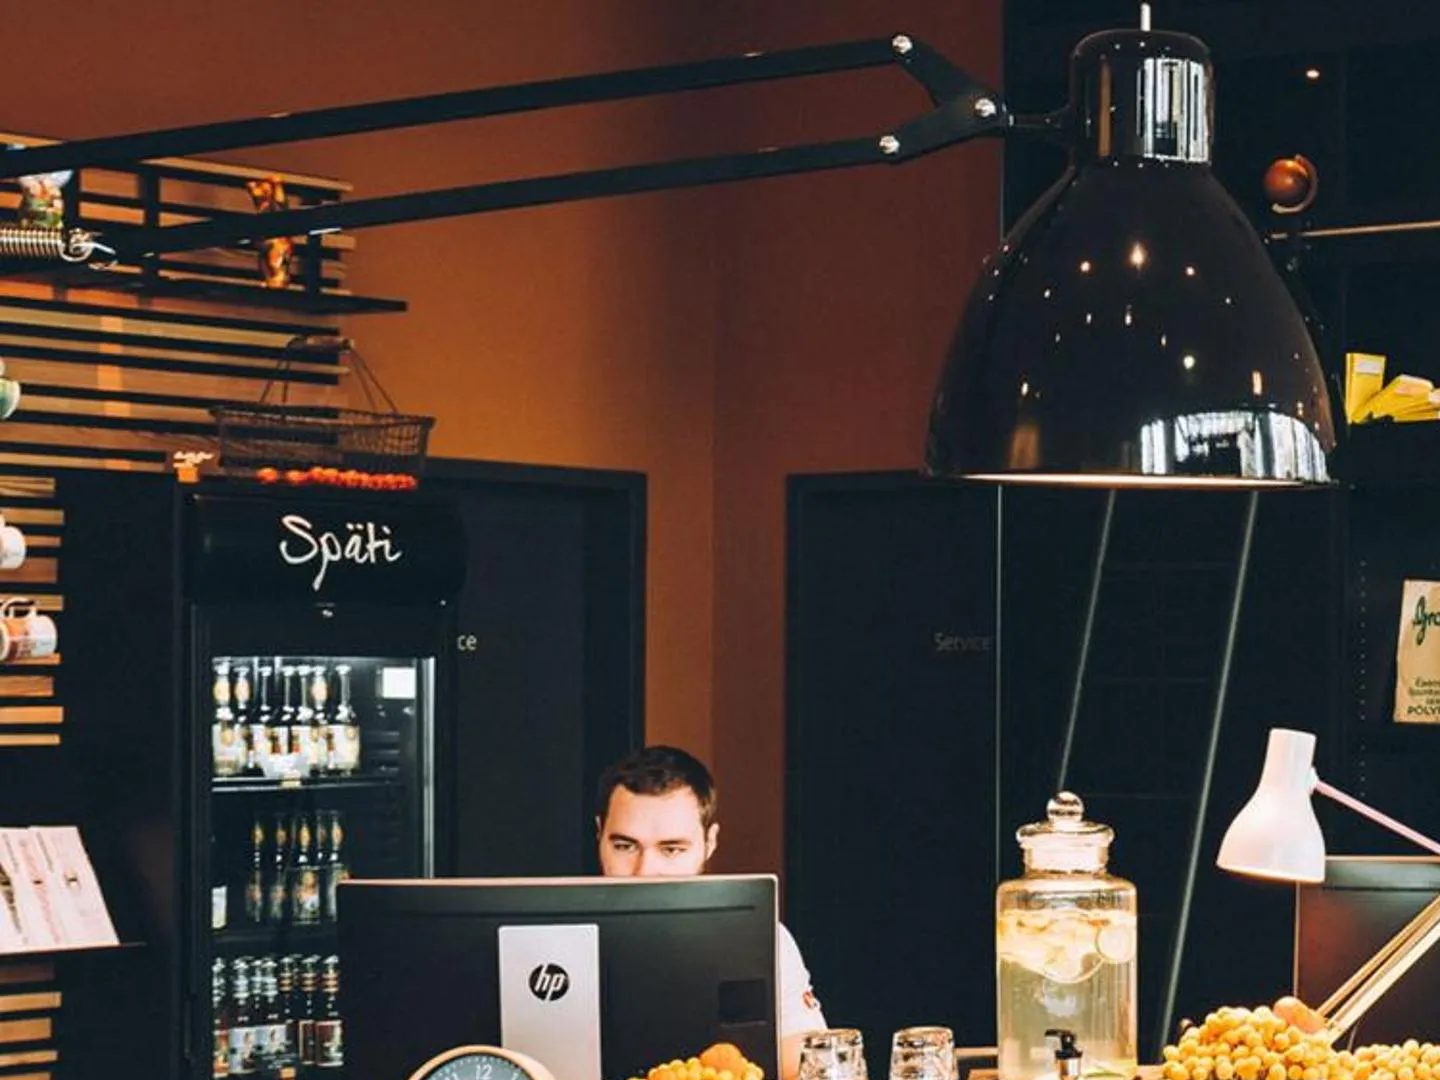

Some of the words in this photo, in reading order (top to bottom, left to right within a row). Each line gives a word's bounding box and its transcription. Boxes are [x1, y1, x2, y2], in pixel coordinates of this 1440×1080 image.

[279, 514, 402, 592] Späti
[531, 963, 568, 1001] hp
[475, 1063, 493, 1080] 12
